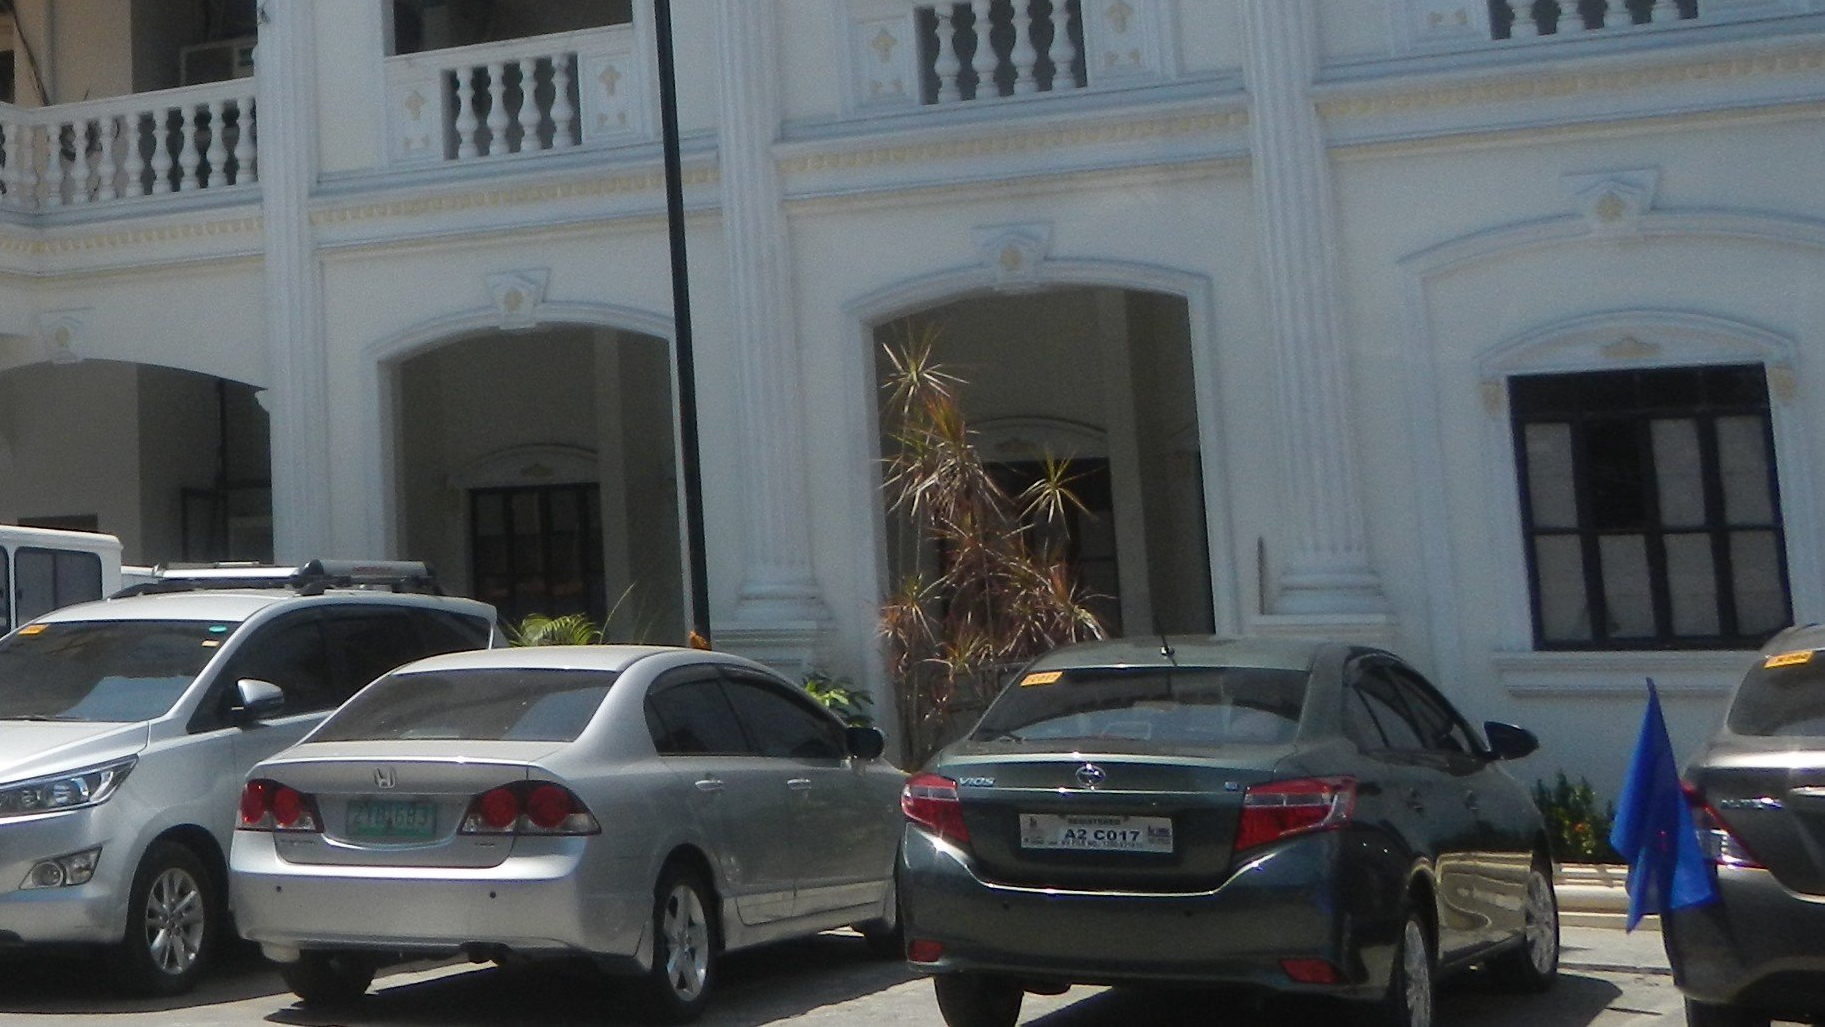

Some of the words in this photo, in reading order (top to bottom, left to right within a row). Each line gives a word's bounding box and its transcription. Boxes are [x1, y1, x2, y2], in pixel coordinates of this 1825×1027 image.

[958, 775, 996, 788] VIOS
[1064, 828, 1087, 841] A2
[1093, 829, 1141, 841] C017
